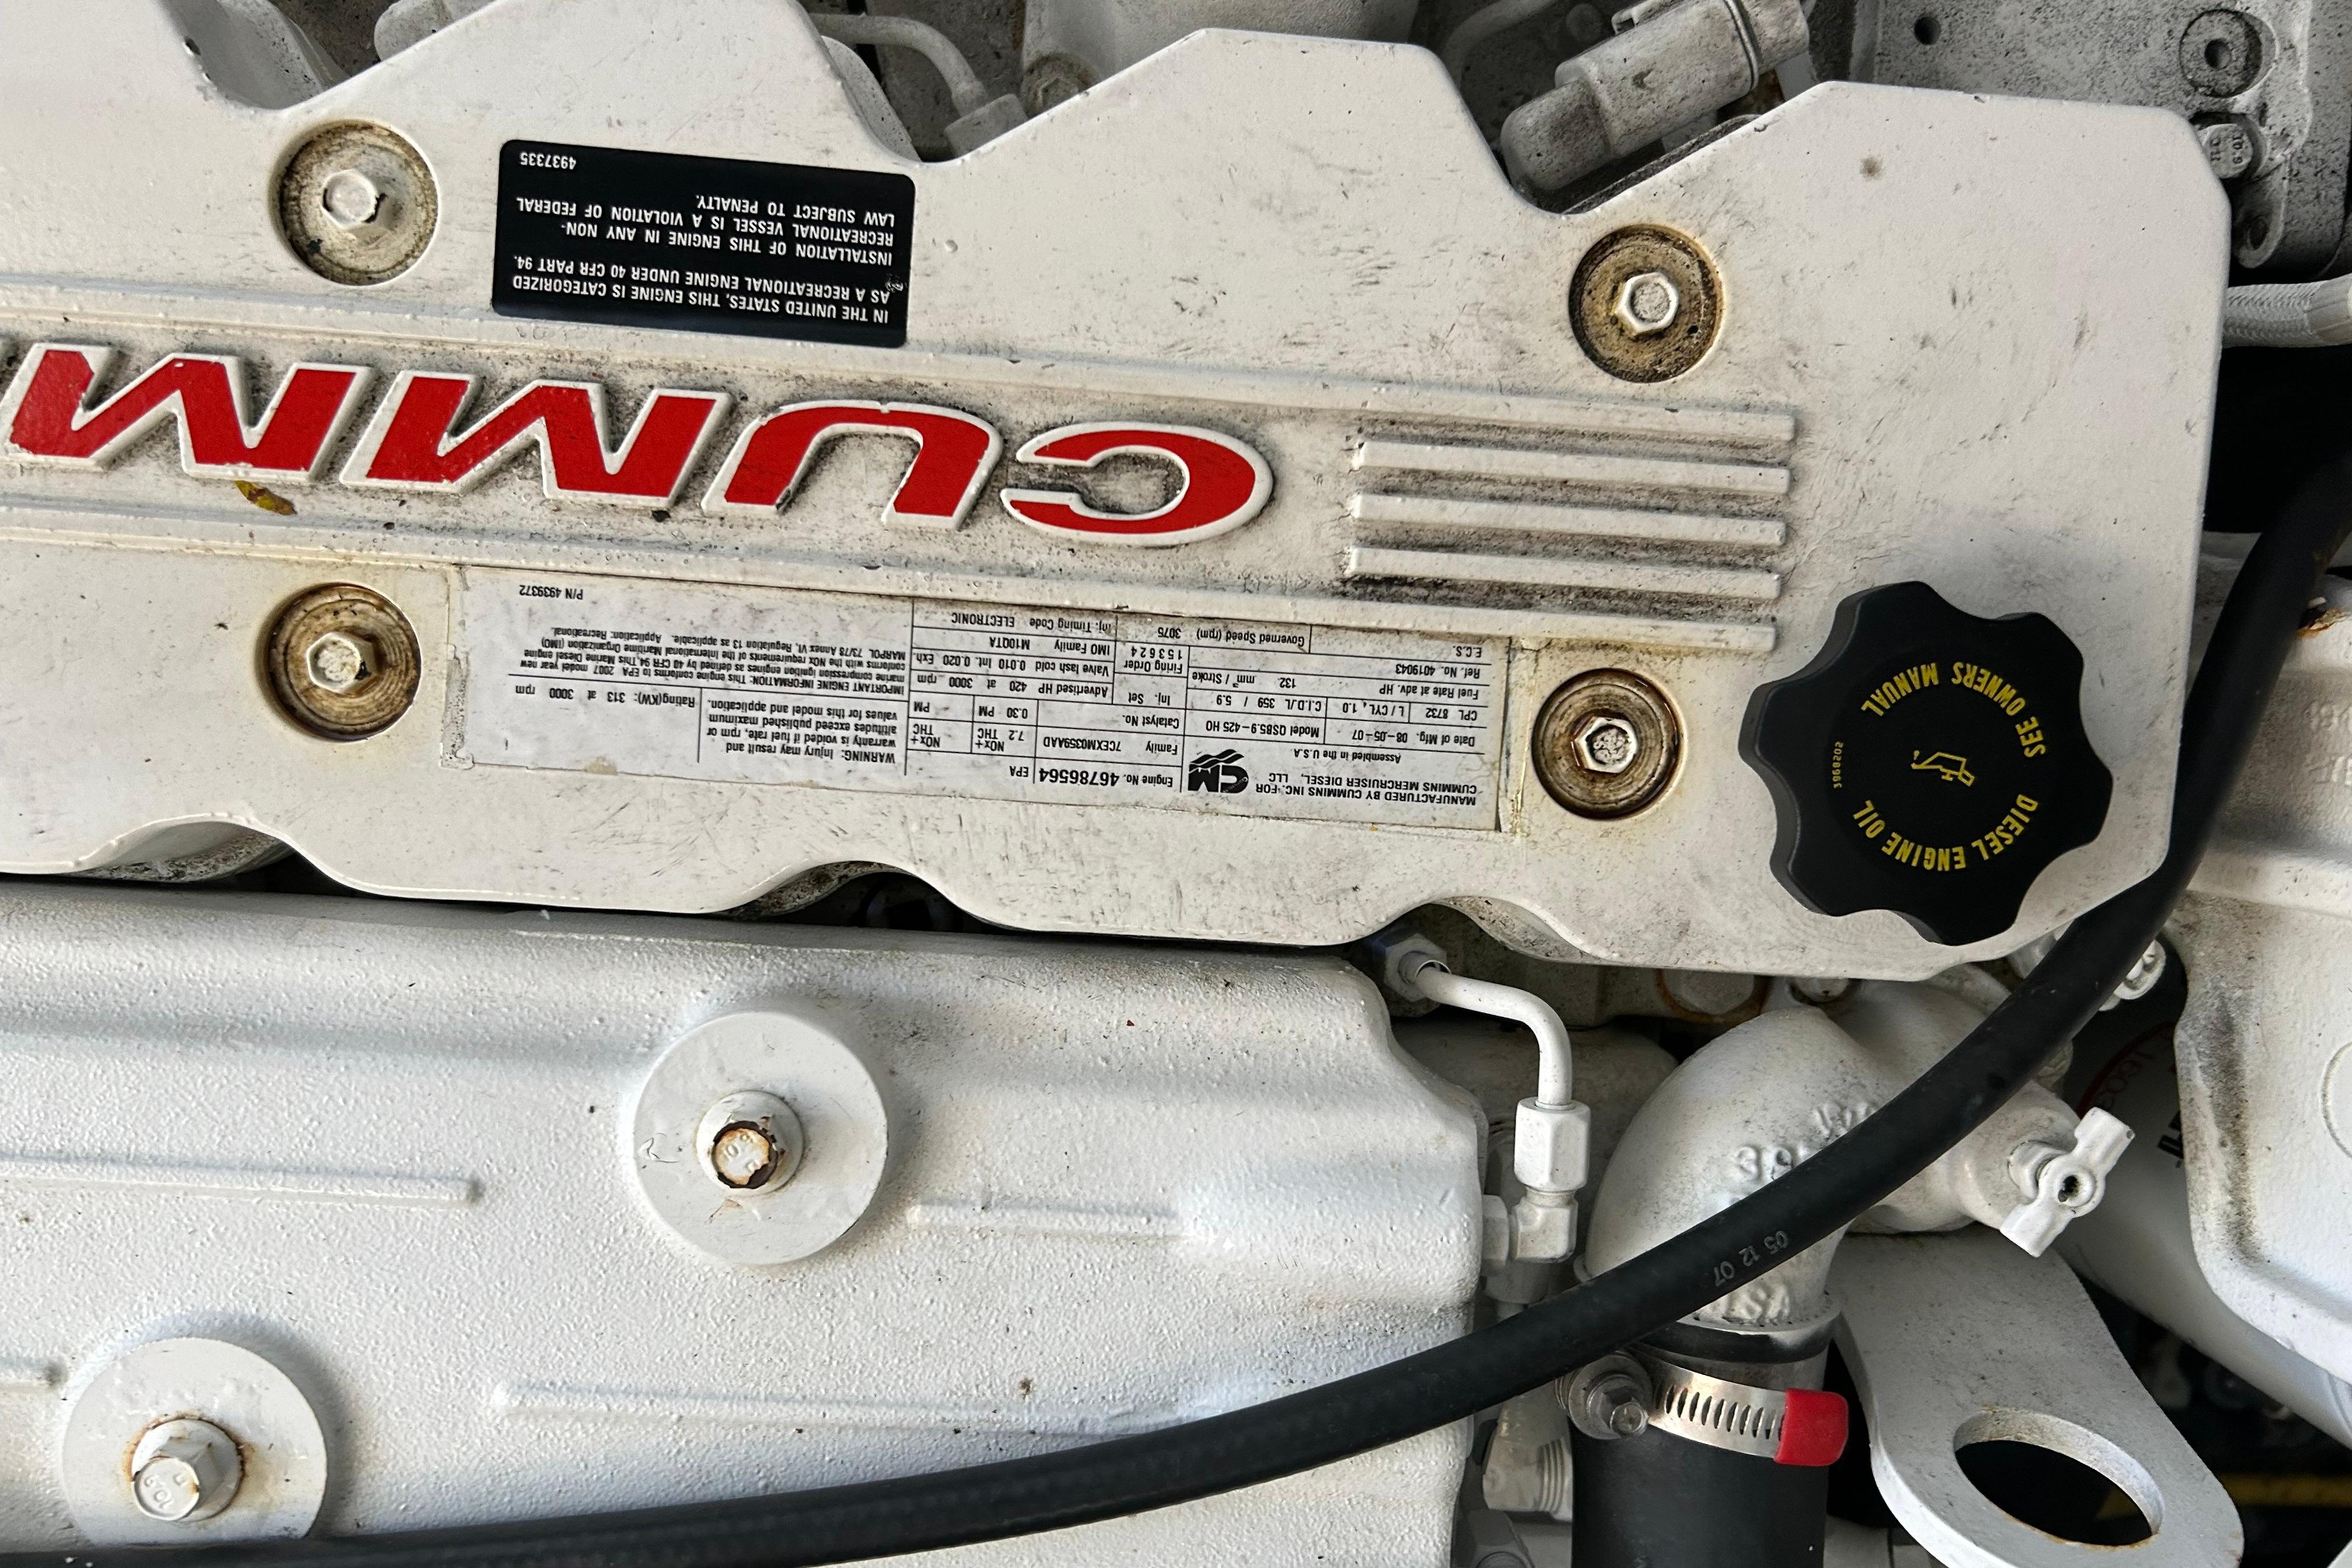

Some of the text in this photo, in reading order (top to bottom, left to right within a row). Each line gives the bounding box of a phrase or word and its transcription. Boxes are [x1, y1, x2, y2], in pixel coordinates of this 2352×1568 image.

[520, 152, 576, 169] 4937335
[696, 195, 894, 227] LAW SUBJECT TO PENALTY.
[516, 197, 893, 246] RECREATIONAL VESSEL IS A VIOLATION OF FEDERAL
[561, 222, 892, 266] INSTALLATION OF THIS ENGINE IN ANY NON-
[514, 256, 890, 304] AS A RECREATIONAL ENGINE UNDER 40 CFR PART 94.
[513, 275, 888, 323] IN THE UNITED STATES, THIS ENGINE IS CATEGORIZED
[519, 584, 583, 600] P/N 4939372
[951, 612, 1014, 627] ELECTRONIC
[1029, 617, 1054, 630] Code
[1058, 617, 1091, 633] Timing
[1157, 626, 1304, 648] Governed Speed (rpm) 3075
[1054, 639, 1087, 654] Family
[1090, 643, 1110, 656] IMO
[520, 660, 537, 668] new
[540, 659, 558, 669] year
[561, 661, 588, 673] model
[593, 664, 614, 675] 2007
[1395, 663, 1480, 679] Ref. No. 4019043
[622, 667, 639, 677] EPA
[642, 667, 651, 677] to
[653, 668, 694, 680] conforms
[696, 671, 725, 681] engine
[727, 673, 746, 684] This
[515, 684, 535, 694] rpm
[817, 680, 849, 691] ENGINE
[852, 682, 904, 695] IMPORTANT
[917, 673, 1108, 698] Advertised HP 420 at 3000 rpm
[1378, 684, 1478, 700] Fuel Rate at adv. HP
[548, 687, 573, 699] 3000
[587, 690, 596, 700] at
[607, 691, 625, 703] 313
[1128, 692, 1144, 705] Set
[707, 699, 897, 722] values for this model and application.
[978, 705, 1028, 719] 0.30 PM
[1425, 707, 1477, 721] CPL 8732
[1860, 661, 2046, 758] SEE OWNERS MANUAL
[708, 713, 897, 736] altitudes exceed published maximum
[1122, 714, 1179, 729] Catalyst No.
[1205, 720, 1220, 732] HO
[706, 727, 896, 747] warranty is voided if fuel rate, rpm or
[977, 727, 1024, 741] 7.2 THC
[1290, 725, 1320, 738] Model
[1416, 731, 1437, 745] Mfg.
[1440, 734, 1450, 746] of
[1453, 735, 1475, 747] Date
[725, 742, 744, 753] and
[748, 743, 776, 754] result
[779, 743, 801, 755] may
[804, 745, 833, 760] Injury
[1145, 740, 1178, 755] Family
[1009, 765, 1028, 777] EPA
[1038, 768, 1172, 788] Engine No. 46786564
[1255, 783, 1278, 793] FOR
[1268, 772, 1476, 794] CUMMINS MERCRUISER DIESEL, LLC
[1308, 786, 1362, 799] CUMMINS
[1364, 790, 1380, 800] BY
[1384, 791, 1476, 806] MANUFACTURED
[1853, 794, 2039, 872] DIESEL ENGINE OIL
[1713, 1230, 1789, 1287] 05 12 07
